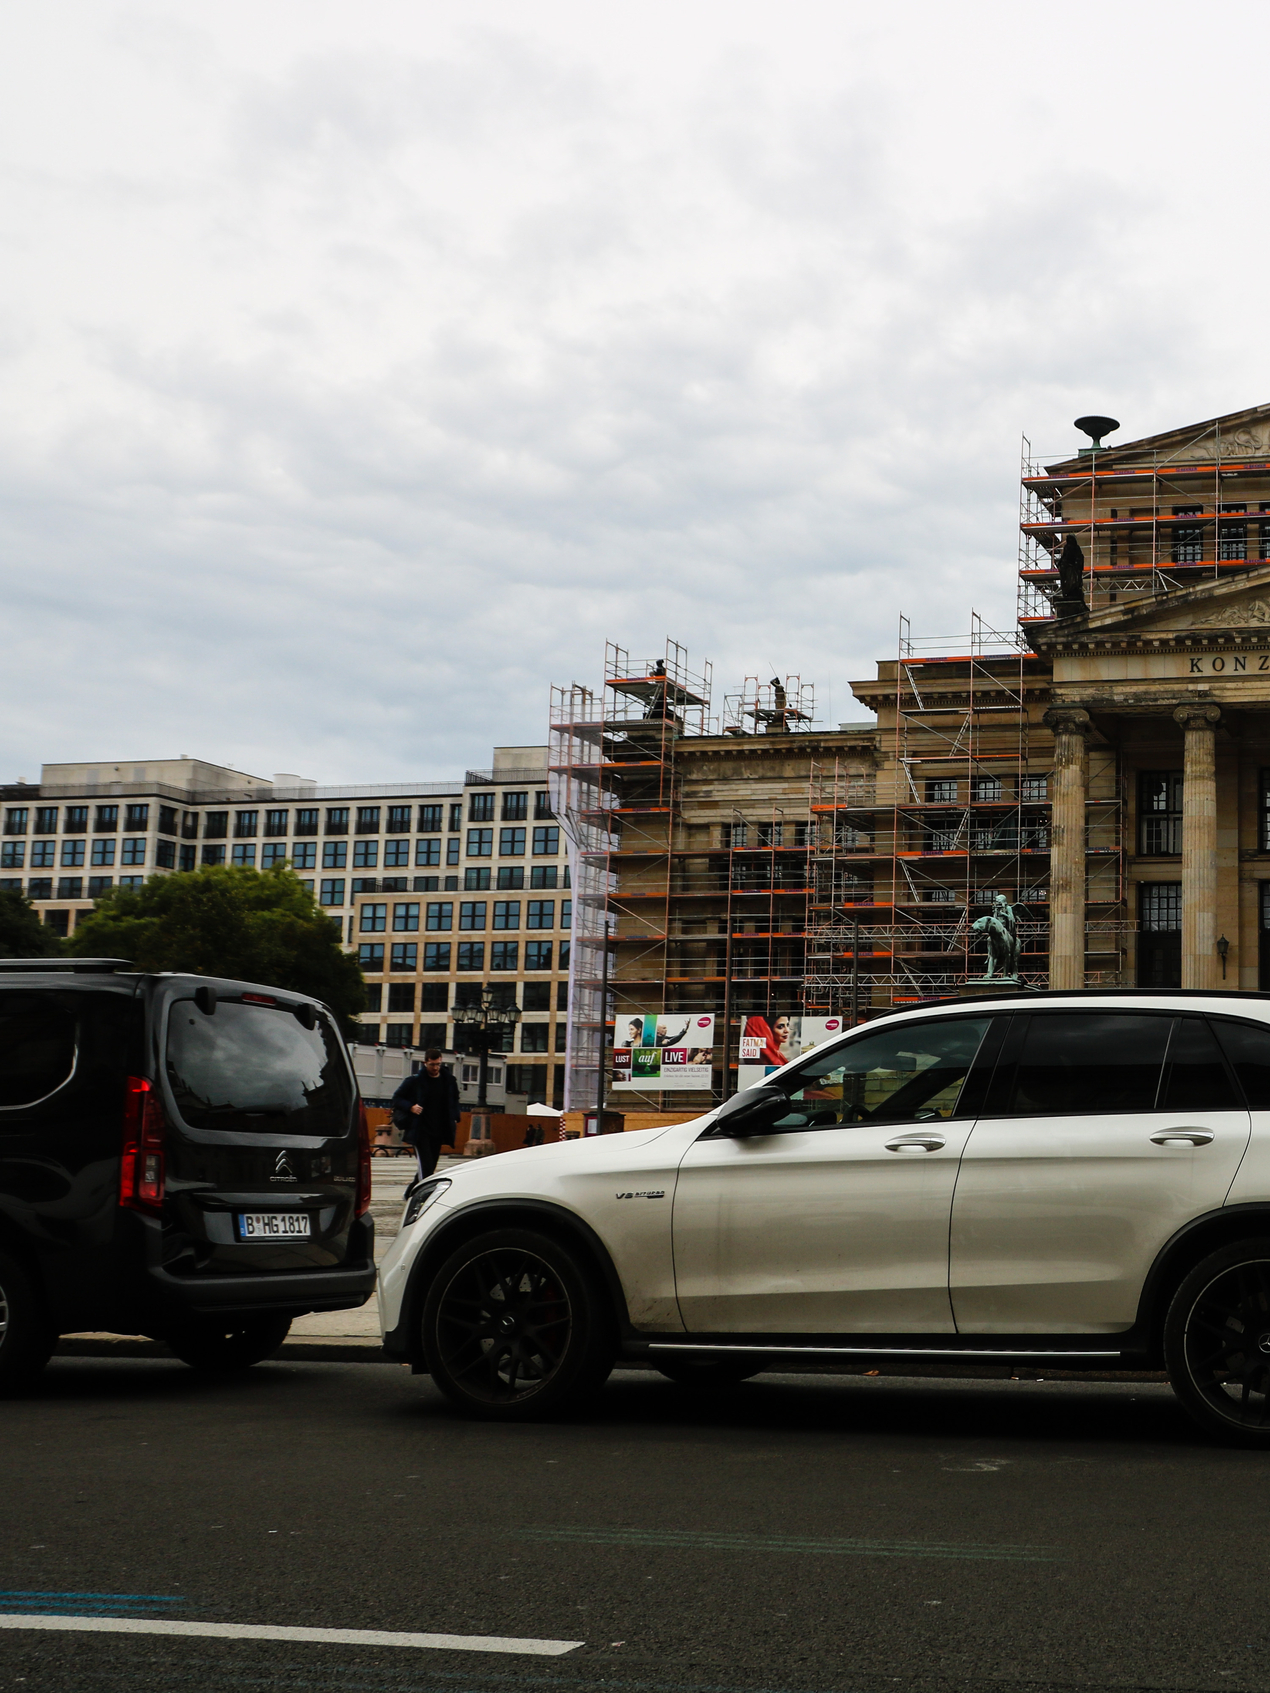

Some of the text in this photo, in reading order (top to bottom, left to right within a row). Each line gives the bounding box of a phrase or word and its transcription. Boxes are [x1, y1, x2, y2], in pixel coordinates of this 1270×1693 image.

[742, 1038, 764, 1047] FATMA
[615, 1051, 685, 1066] LUST auf LIVE
[741, 1048, 756, 1057] SAID
[245, 1216, 308, 1234] B HG 1817
